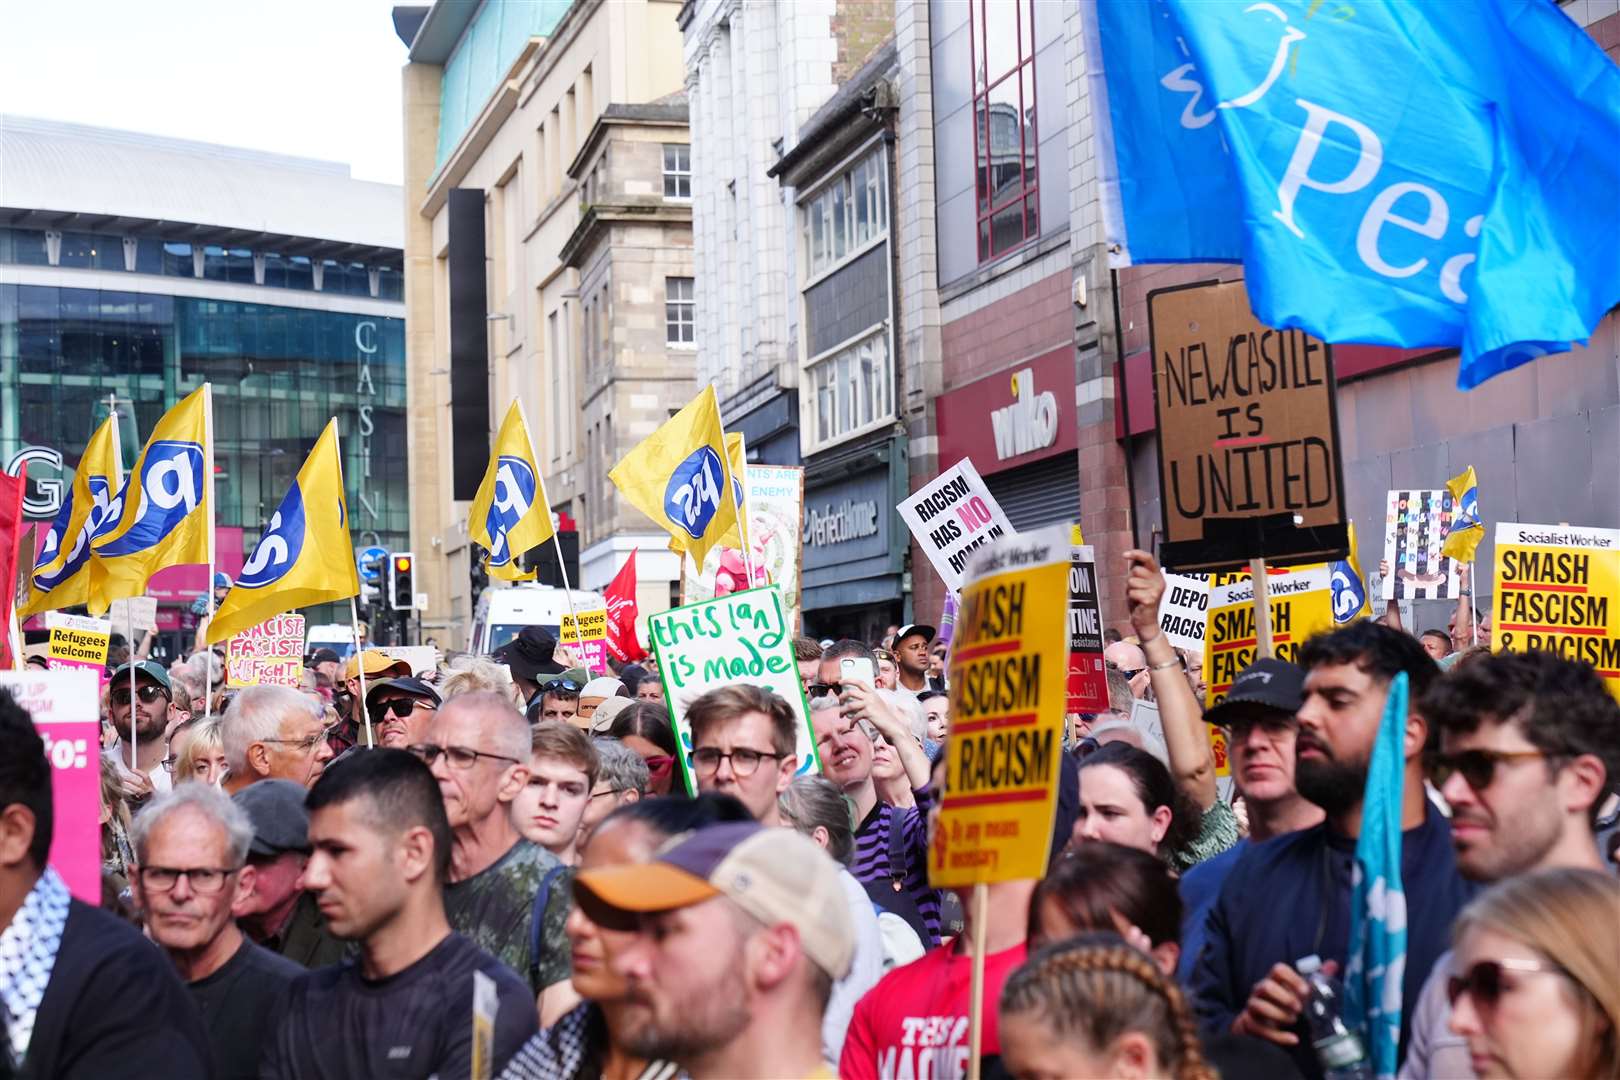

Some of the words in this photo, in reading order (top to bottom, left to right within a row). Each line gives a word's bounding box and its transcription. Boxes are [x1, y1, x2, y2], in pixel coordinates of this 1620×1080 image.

[1165, 328, 1323, 408] NEWCASTLE
[1217, 403, 1264, 440] IS
[752, 486, 793, 497] ENEMY
[776, 470, 799, 481] ARE
[1170, 436, 1332, 519] UNITED
[914, 475, 971, 523] RACISM
[929, 519, 962, 550] HAS
[955, 495, 992, 534] NO
[1519, 531, 1568, 545] Socialist
[1570, 534, 1611, 547] Worker
[1502, 550, 1589, 584] SMASH
[1169, 586, 1208, 611] DEPO
[1228, 585, 1271, 603] Sociat
[1272, 579, 1310, 594] Worker
[563, 614, 605, 628] Reugees
[654, 606, 722, 647] this
[728, 591, 785, 648] land
[1500, 592, 1608, 627] FASCISM
[54, 630, 106, 647] Refugees
[563, 627, 603, 640] wecome
[1161, 614, 1206, 640] RACIS
[52, 645, 102, 659] welcome
[668, 653, 695, 687] is
[704, 636, 791, 682] made
[1213, 643, 1301, 684] FASS
[1527, 634, 1620, 668] RACISM
[259, 677, 298, 685] BACK
[960, 729, 1053, 792] RACISM
